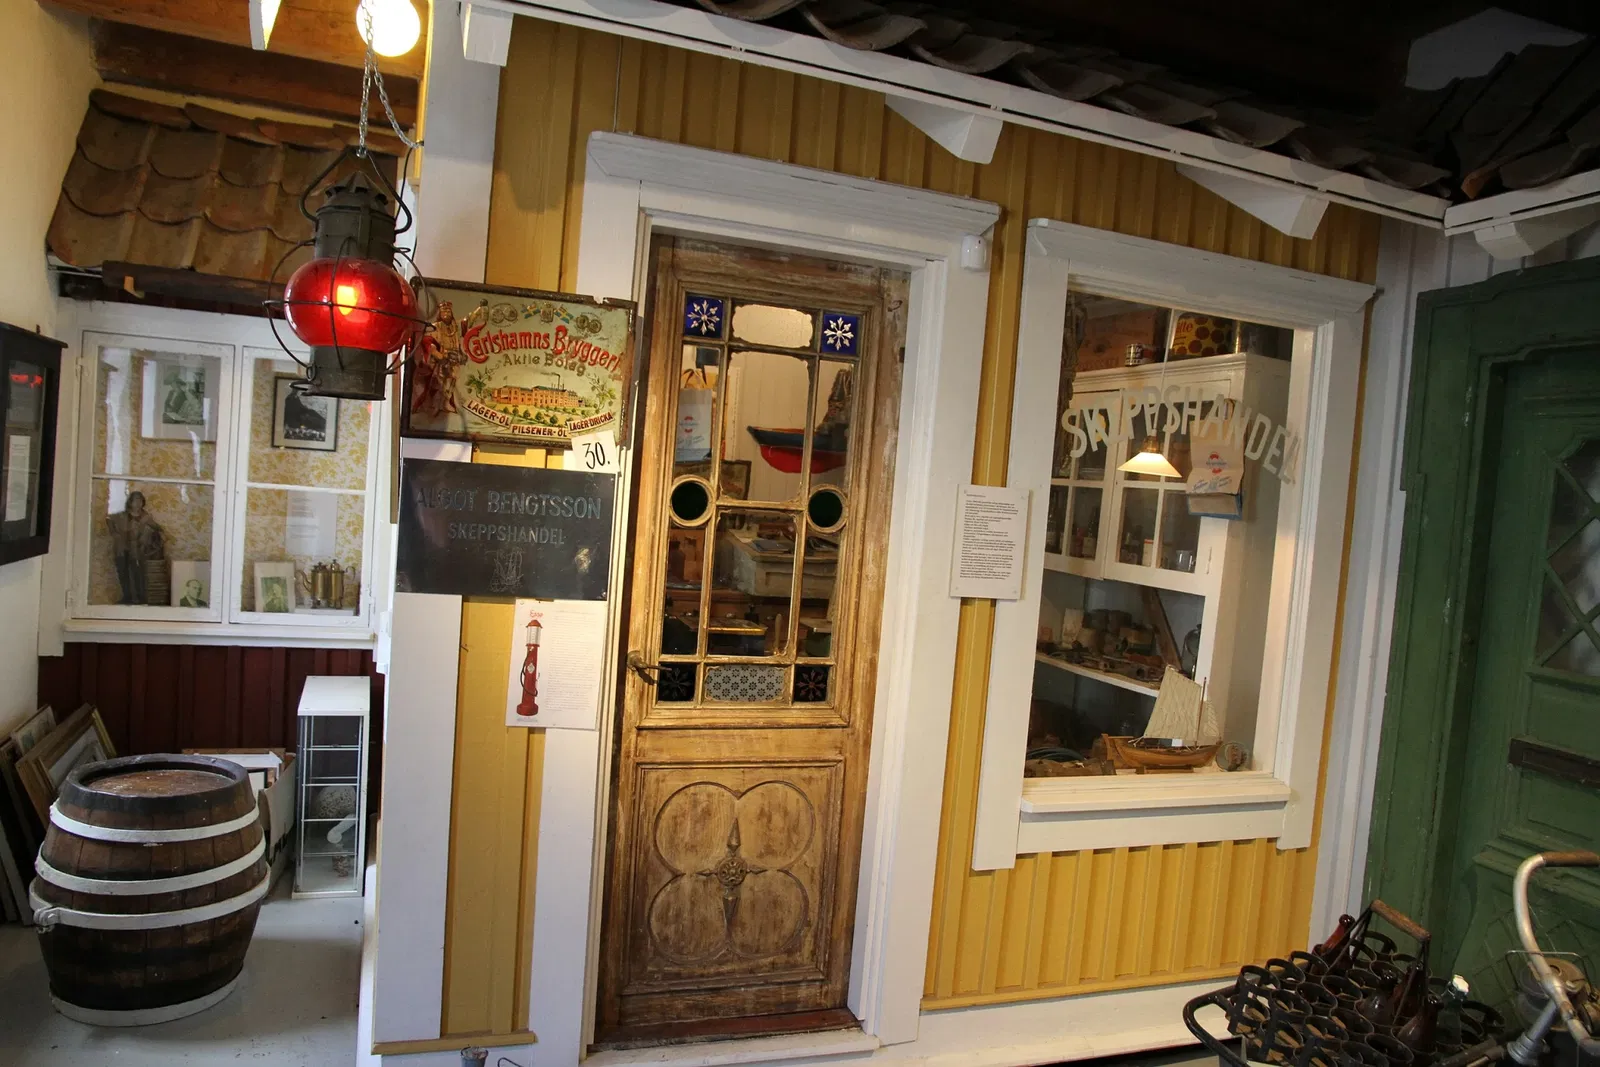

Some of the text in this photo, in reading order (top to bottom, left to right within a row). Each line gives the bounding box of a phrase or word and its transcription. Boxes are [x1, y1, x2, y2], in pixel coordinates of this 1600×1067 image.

[463, 321, 550, 363] Carlshamns
[503, 352, 586, 376] Aktie Bolag
[487, 490, 601, 519] BENGTSSON
[449, 522, 566, 546] SKEPPSHANDEL
